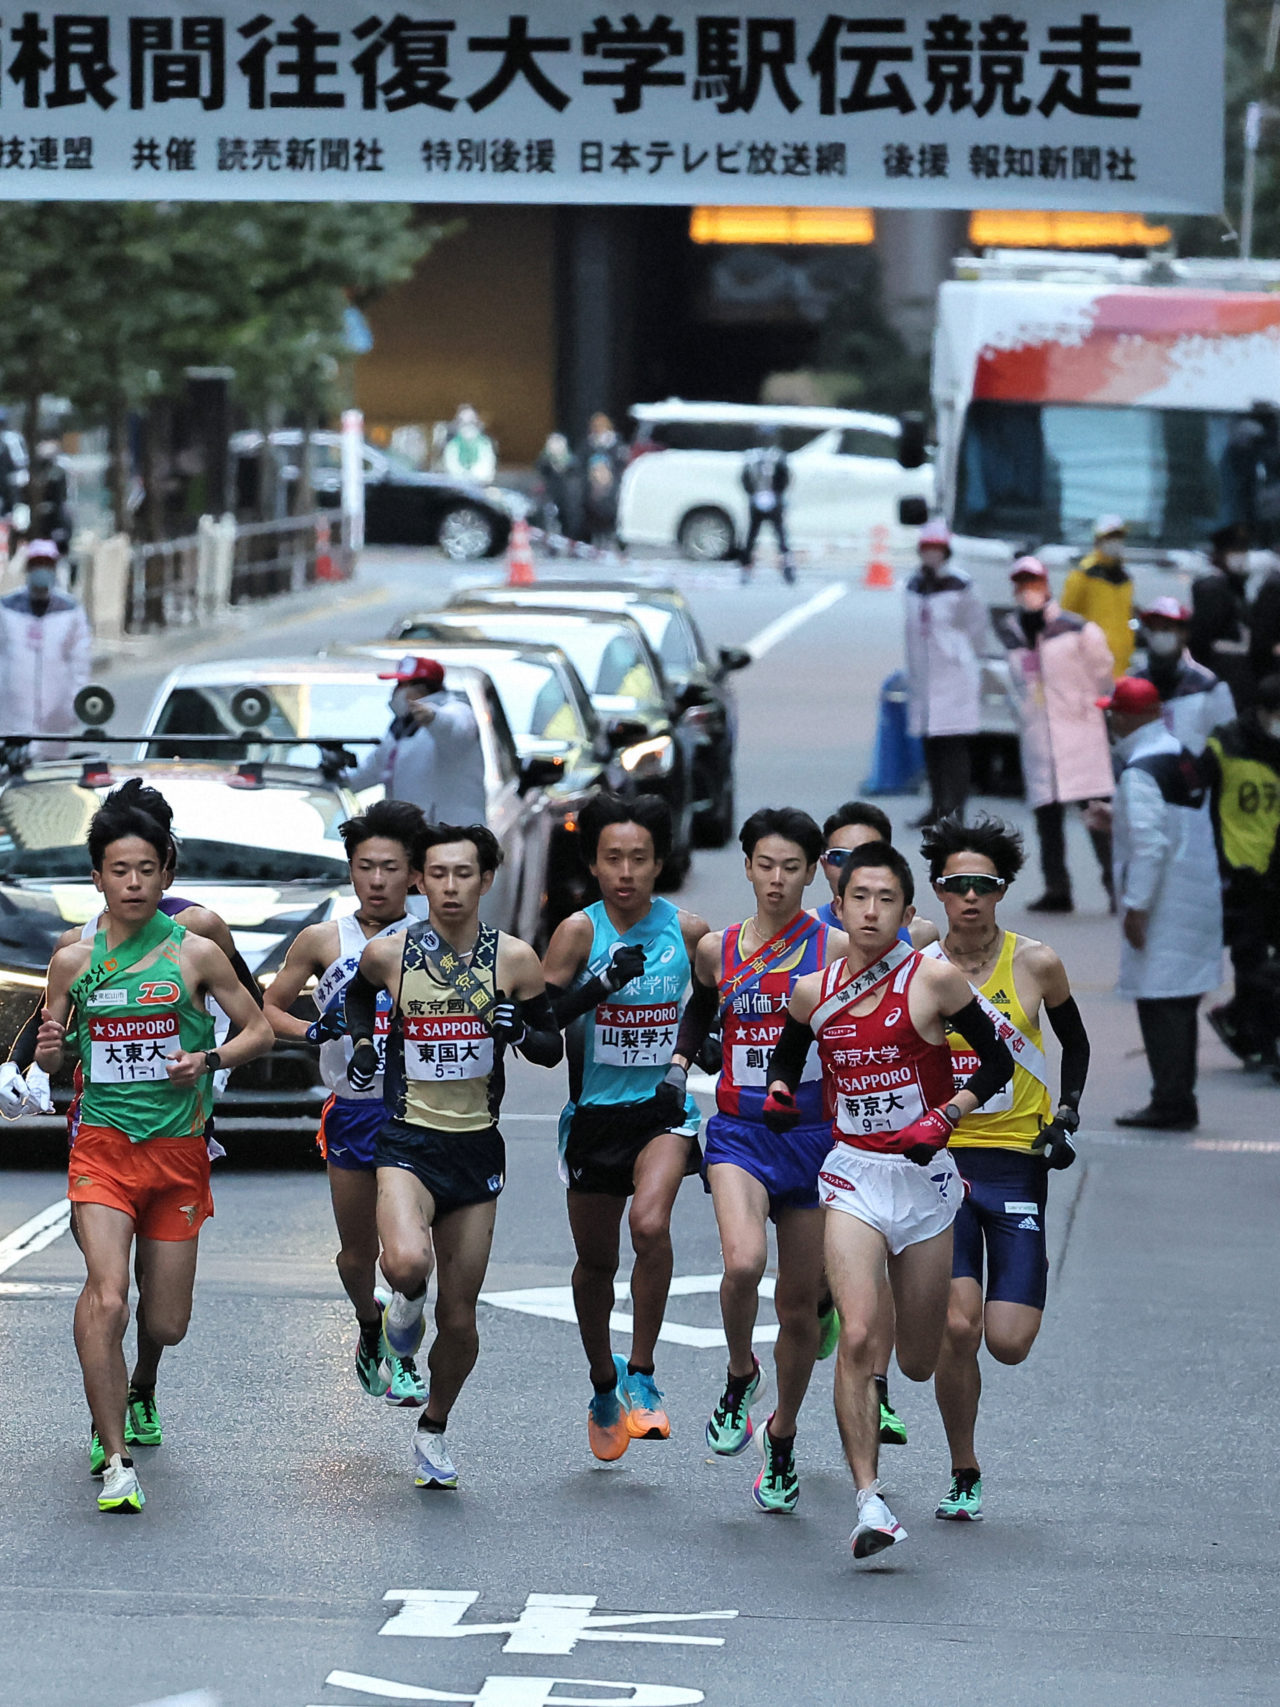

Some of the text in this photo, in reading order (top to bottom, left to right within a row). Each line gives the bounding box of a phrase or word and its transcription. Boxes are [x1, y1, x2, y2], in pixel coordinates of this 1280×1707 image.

[131, 137, 196, 171] 共催
[217, 137, 384, 171] 読売新聞社
[422, 139, 556, 173] 特別後援
[579, 140, 847, 177] 日本テレビ放送網
[883, 143, 950, 178] 後援
[969, 145, 1137, 182] 報知新聞社
[616, 1006, 677, 1024] SAPPORO
[107, 1018, 175, 1037] SAPPORO
[602, 1027, 674, 1049] 山梨学大
[105, 1041, 167, 1064] 大東大
[417, 1042, 480, 1063] 東国大
[622, 1050, 658, 1064] 17-1
[746, 1047, 775, 1072] 創
[832, 1045, 901, 1068] 帝京大学
[118, 1064, 156, 1080] 11-1
[435, 1064, 464, 1078] 5-1
[844, 1067, 912, 1092] SAPPORO
[844, 1092, 905, 1118] 帝京大
[862, 1118, 892, 1132] 9-1
